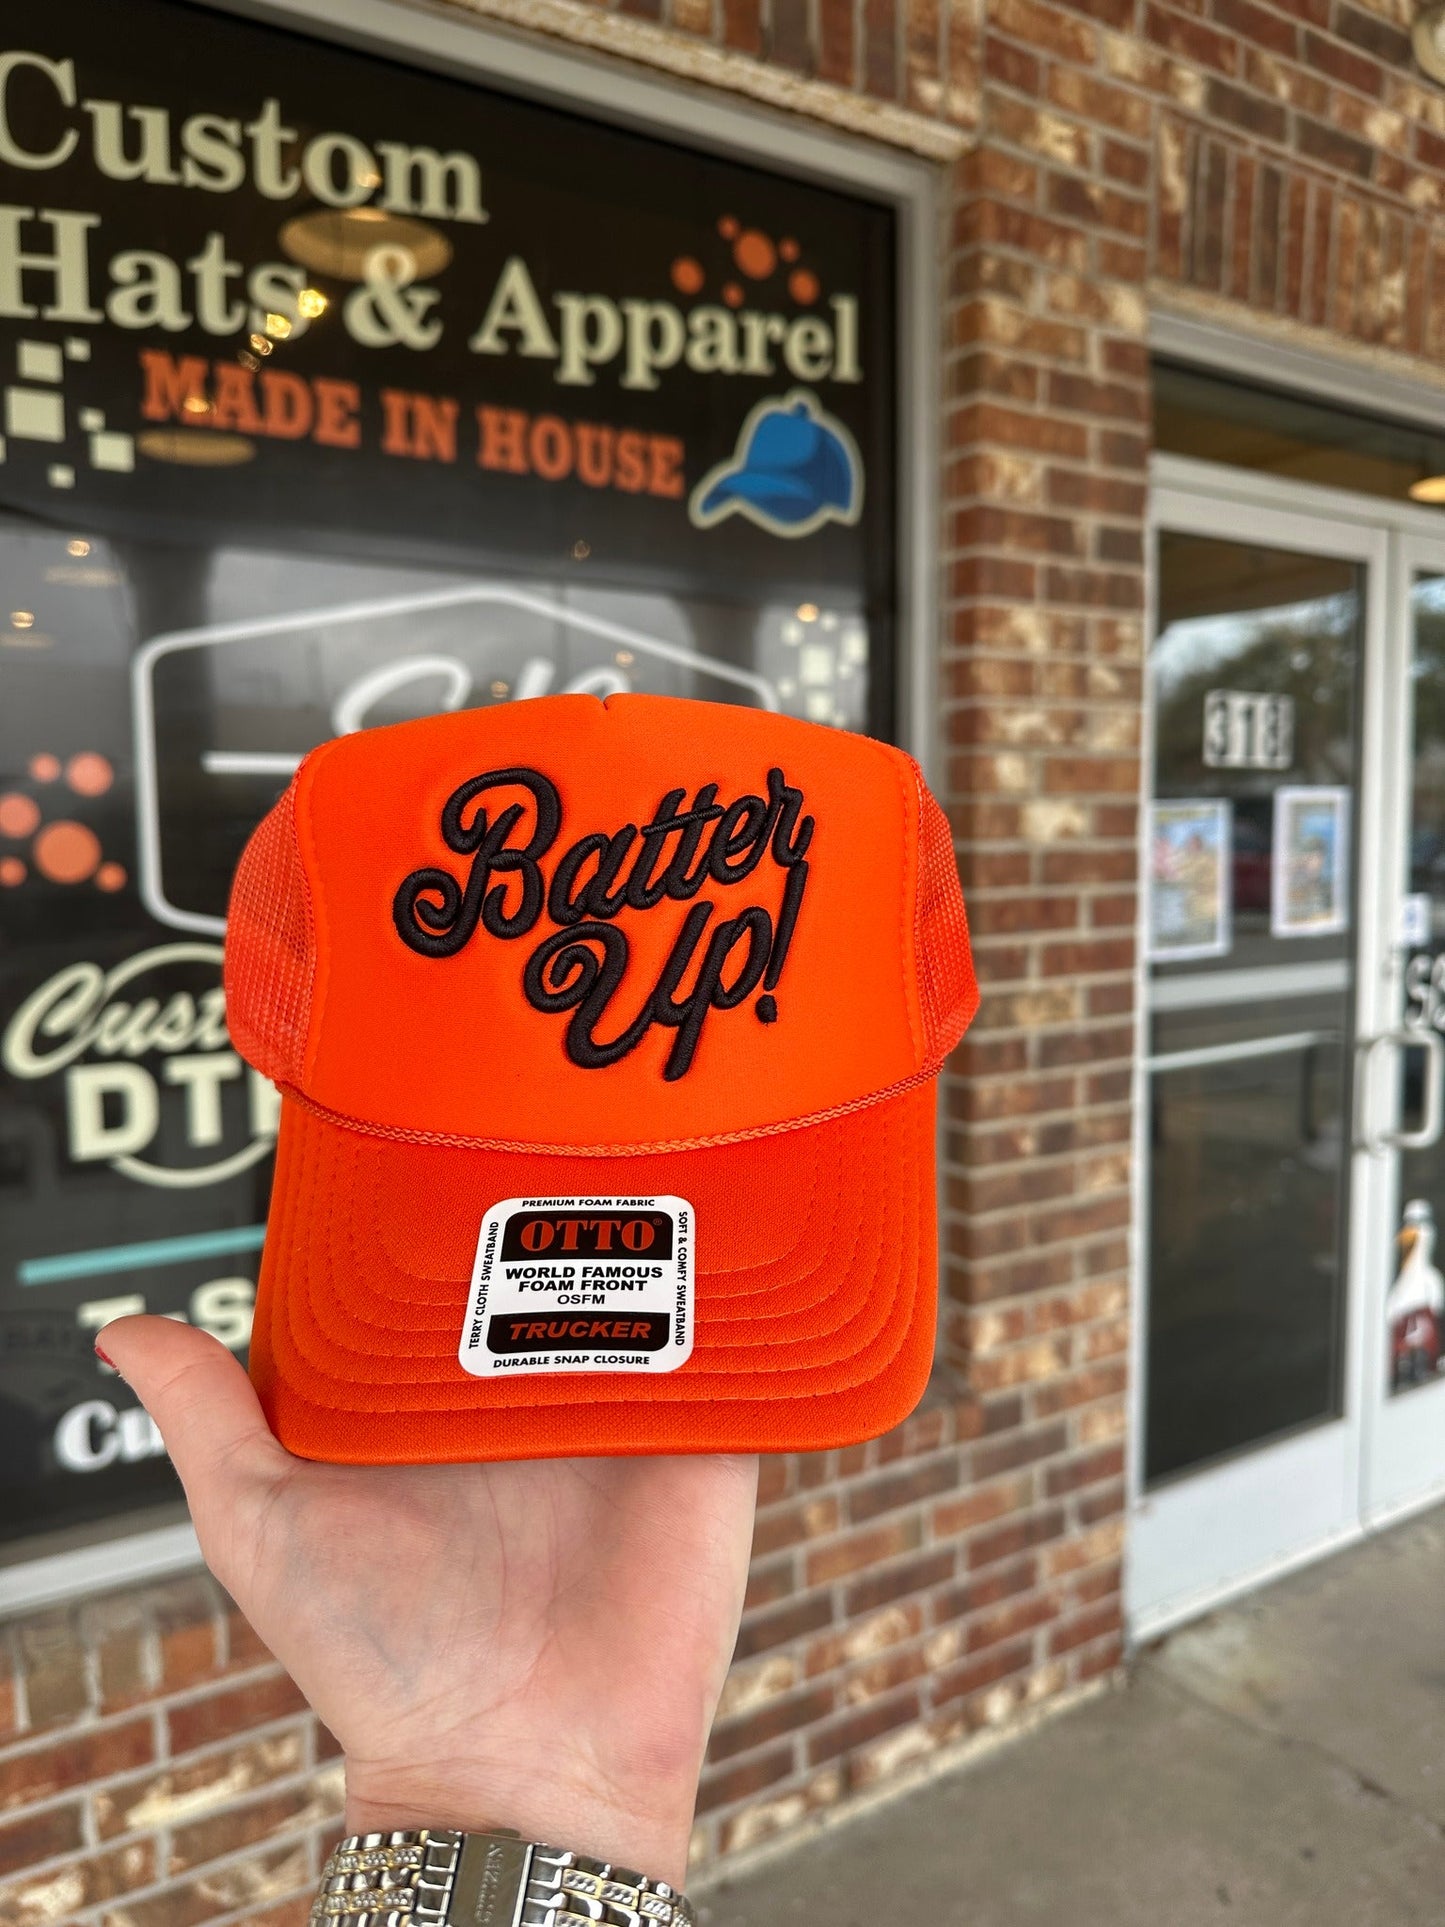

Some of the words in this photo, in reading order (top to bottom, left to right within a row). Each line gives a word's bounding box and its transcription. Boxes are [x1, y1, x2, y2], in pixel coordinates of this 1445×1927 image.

[0, 50, 489, 224] Custom
[0, 204, 310, 341] Hats
[343, 243, 443, 351] &
[468, 255, 863, 390] Apparel
[138, 347, 362, 449] MADE
[380, 388, 459, 464] IN
[476, 403, 685, 499] HOUSE
[393, 767, 815, 958] Batter
[523, 860, 808, 1082] Up!
[2, 961, 228, 1079] Cust
[521, 1199, 575, 1207] PREMIUM
[578, 1199, 613, 1207] FOAM
[616, 1199, 656, 1207] FABRIC
[678, 1211, 688, 1234] SOFT
[481, 1221, 499, 1280] SWEATBAND
[677, 1248, 687, 1282] COMFY
[505, 1267, 576, 1280] WORLD
[581, 1266, 663, 1279] FAMOUS
[518, 1280, 575, 1293] FOAM
[580, 1280, 648, 1291] FRONT
[475, 1284, 490, 1316] CLOTH
[557, 1294, 606, 1304] OSFM
[675, 1284, 687, 1346] SWEATBAND
[468, 1319, 483, 1349] TERRY
[509, 1321, 652, 1341] TRUCKER
[493, 1356, 550, 1368] DURABLE
[553, 1355, 590, 1364] SNAP
[593, 1355, 650, 1364] CLOSURE
